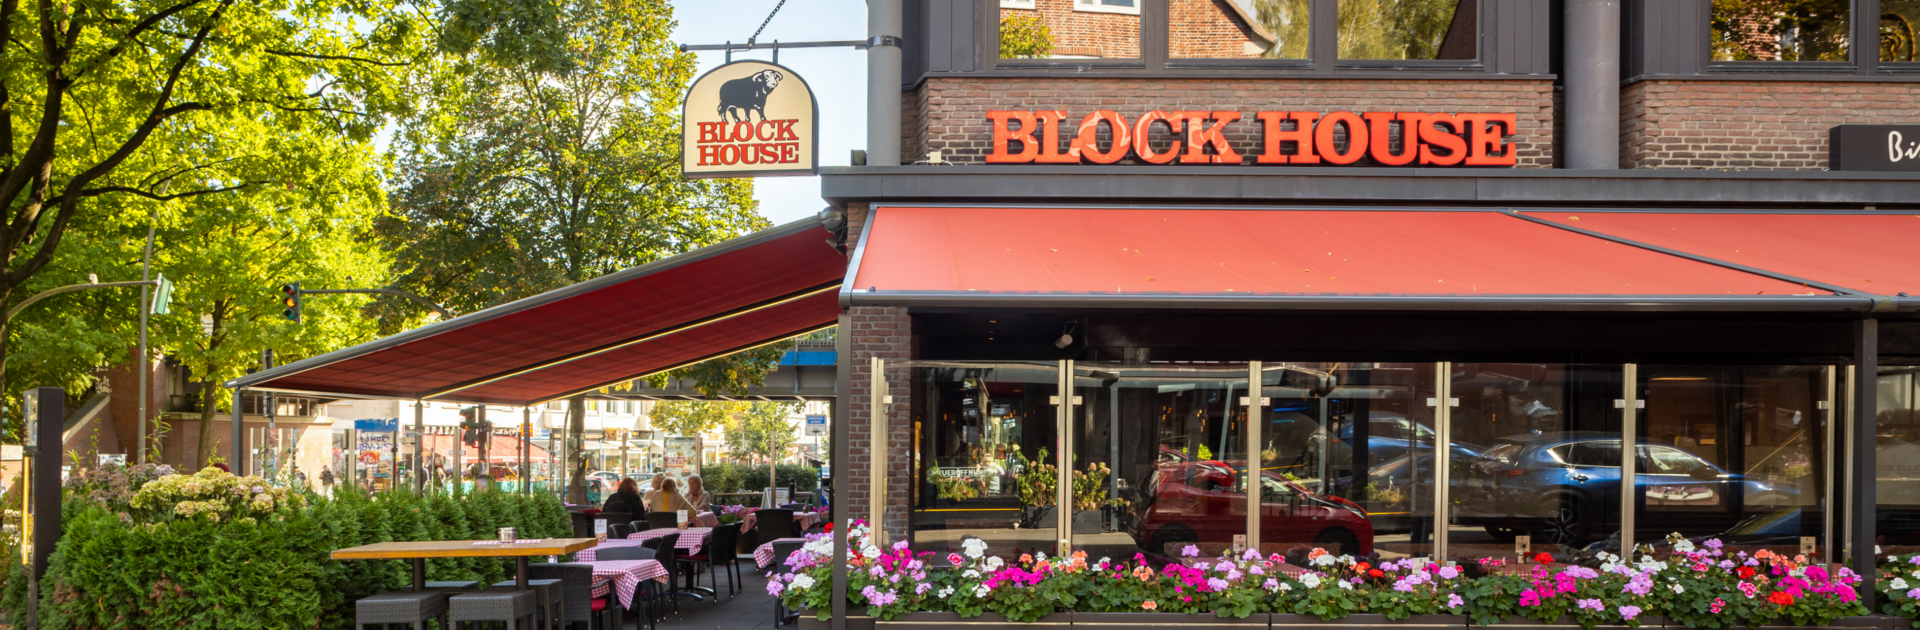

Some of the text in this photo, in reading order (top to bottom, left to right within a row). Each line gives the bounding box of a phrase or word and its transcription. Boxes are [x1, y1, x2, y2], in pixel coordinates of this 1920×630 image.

[697, 119, 799, 144] BLOCK
[985, 109, 1517, 167] BLOCK HOUSE
[696, 142, 799, 166] HOUSE
